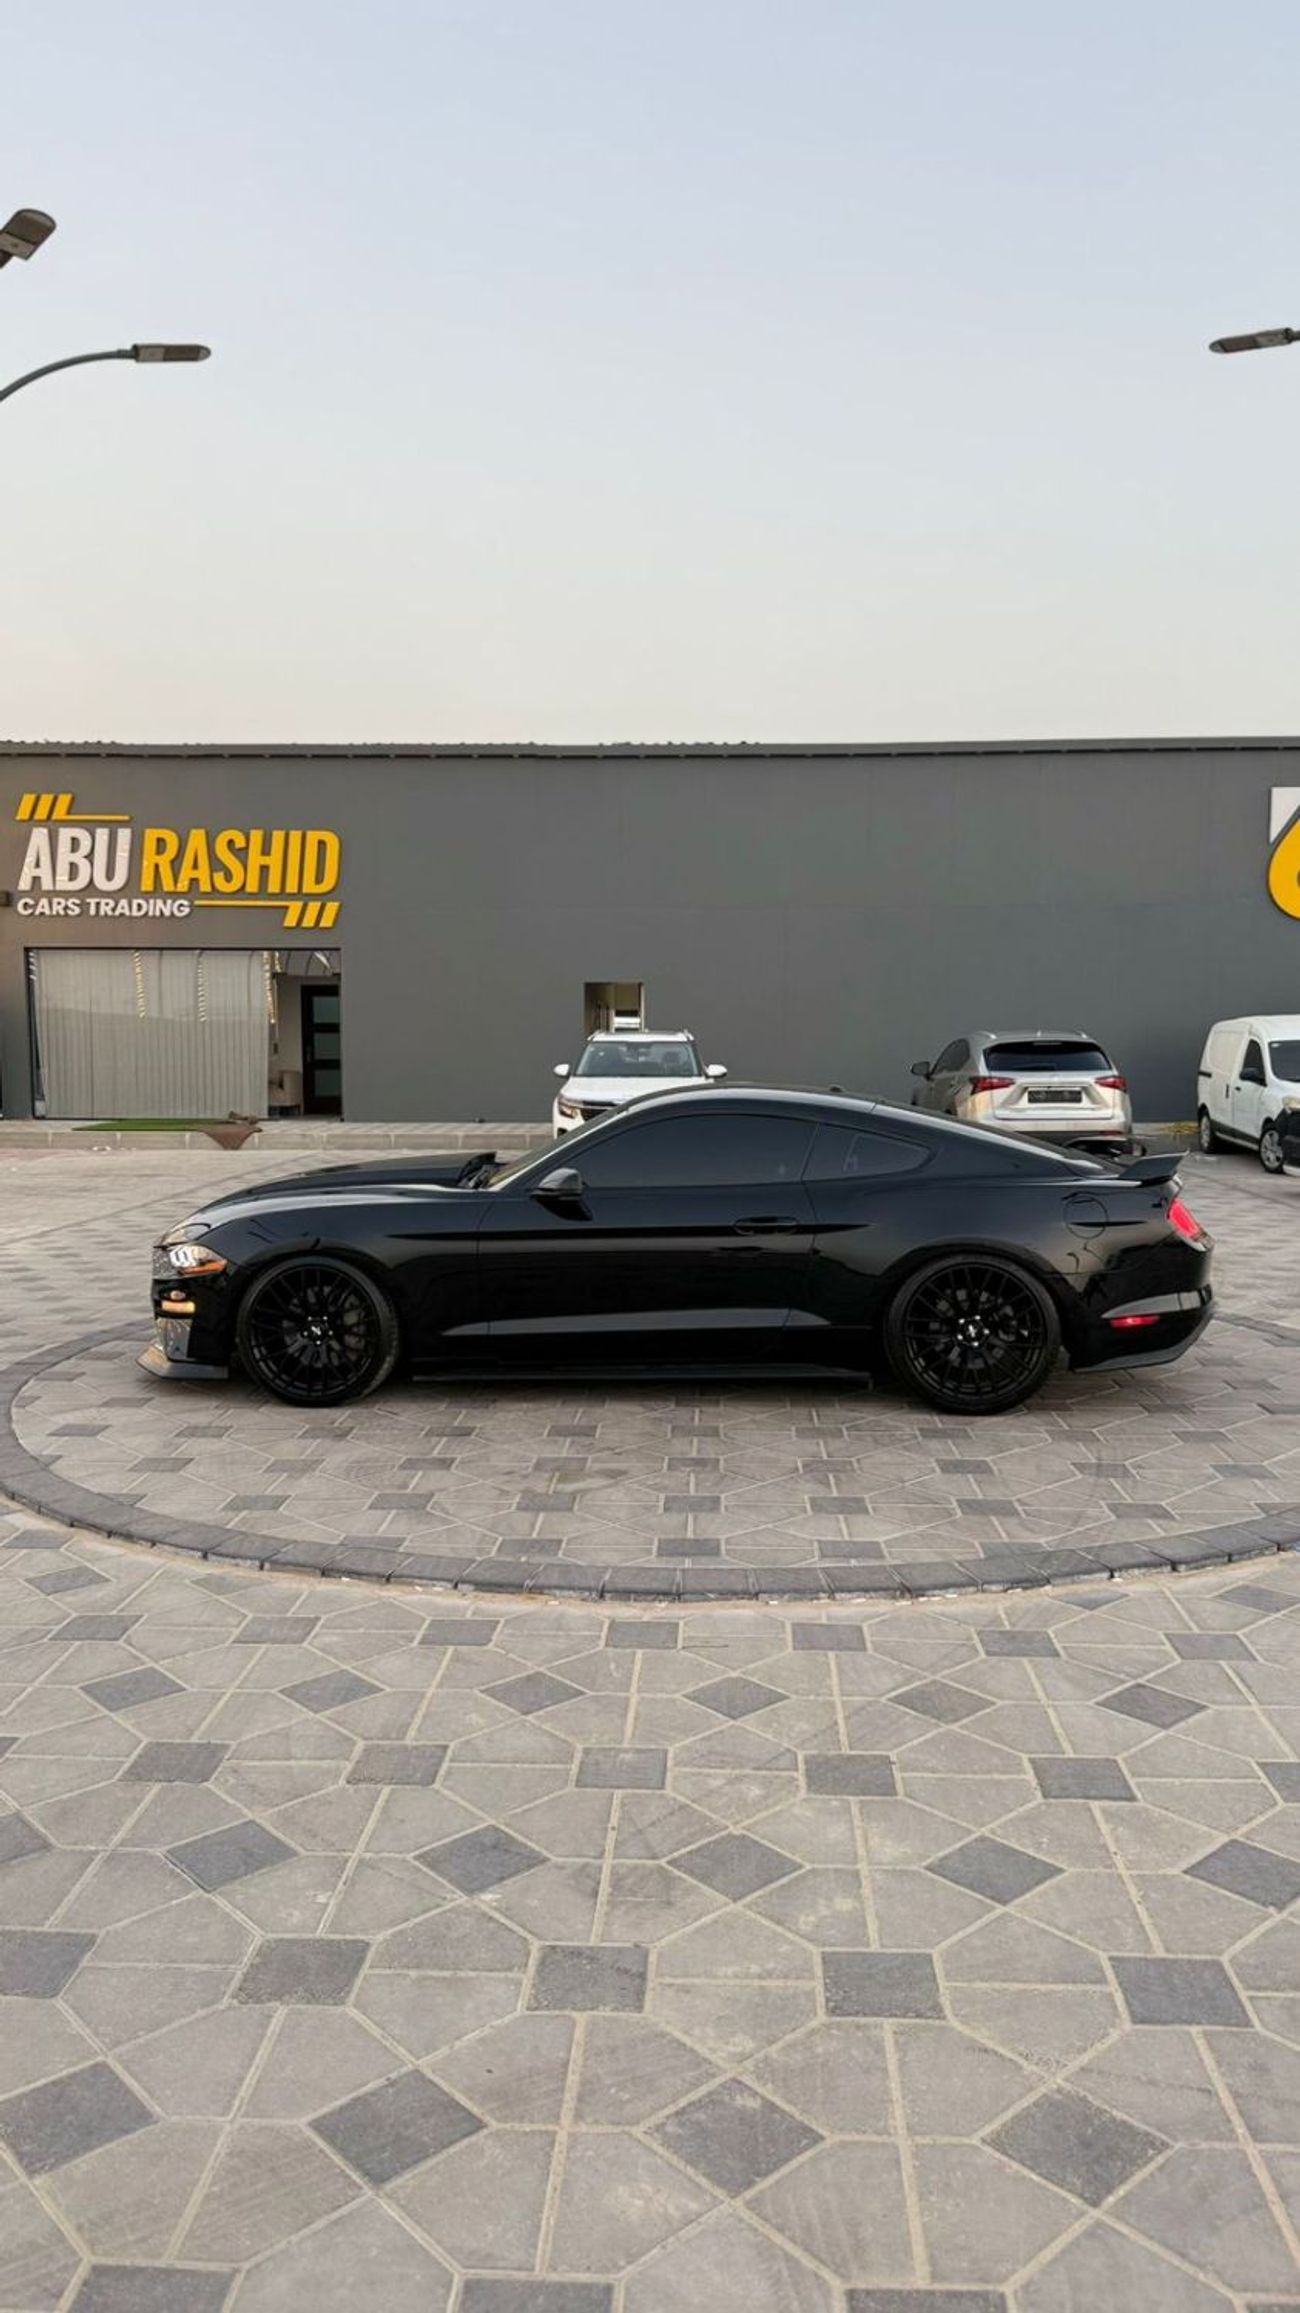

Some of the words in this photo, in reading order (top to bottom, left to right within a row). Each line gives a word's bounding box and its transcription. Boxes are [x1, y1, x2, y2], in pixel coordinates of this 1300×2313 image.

[17, 827, 132, 892] ABU
[140, 828, 341, 894] RASHID
[16, 898, 81, 916] CARS
[85, 898, 192, 918] TRADING
